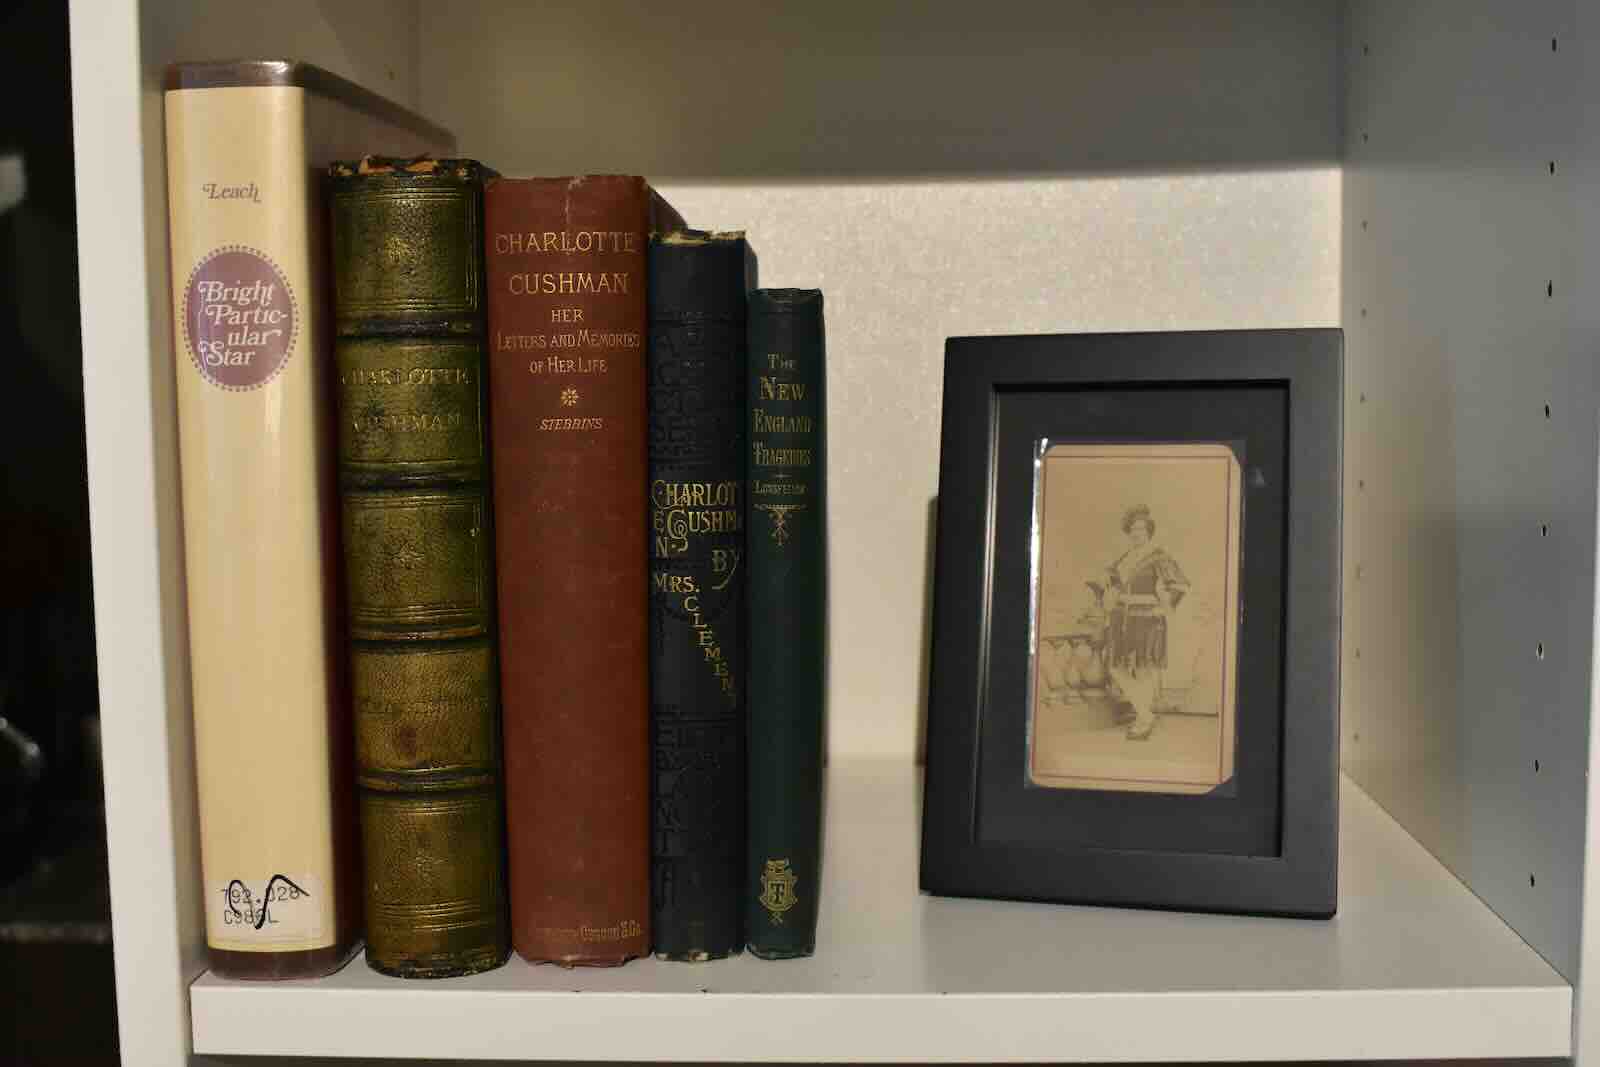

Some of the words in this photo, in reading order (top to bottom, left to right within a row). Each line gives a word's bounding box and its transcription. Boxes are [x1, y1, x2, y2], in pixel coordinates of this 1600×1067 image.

[202, 183, 261, 203] Leach
[496, 231, 636, 253] CHARLOTTE
[198, 280, 273, 307] Bright
[510, 272, 629, 296] CUSHMAN
[208, 304, 289, 326] Partic-
[551, 308, 585, 323] HER
[227, 326, 283, 347] ular
[199, 340, 256, 367] Star
[539, 416, 604, 431] STEBBINS
